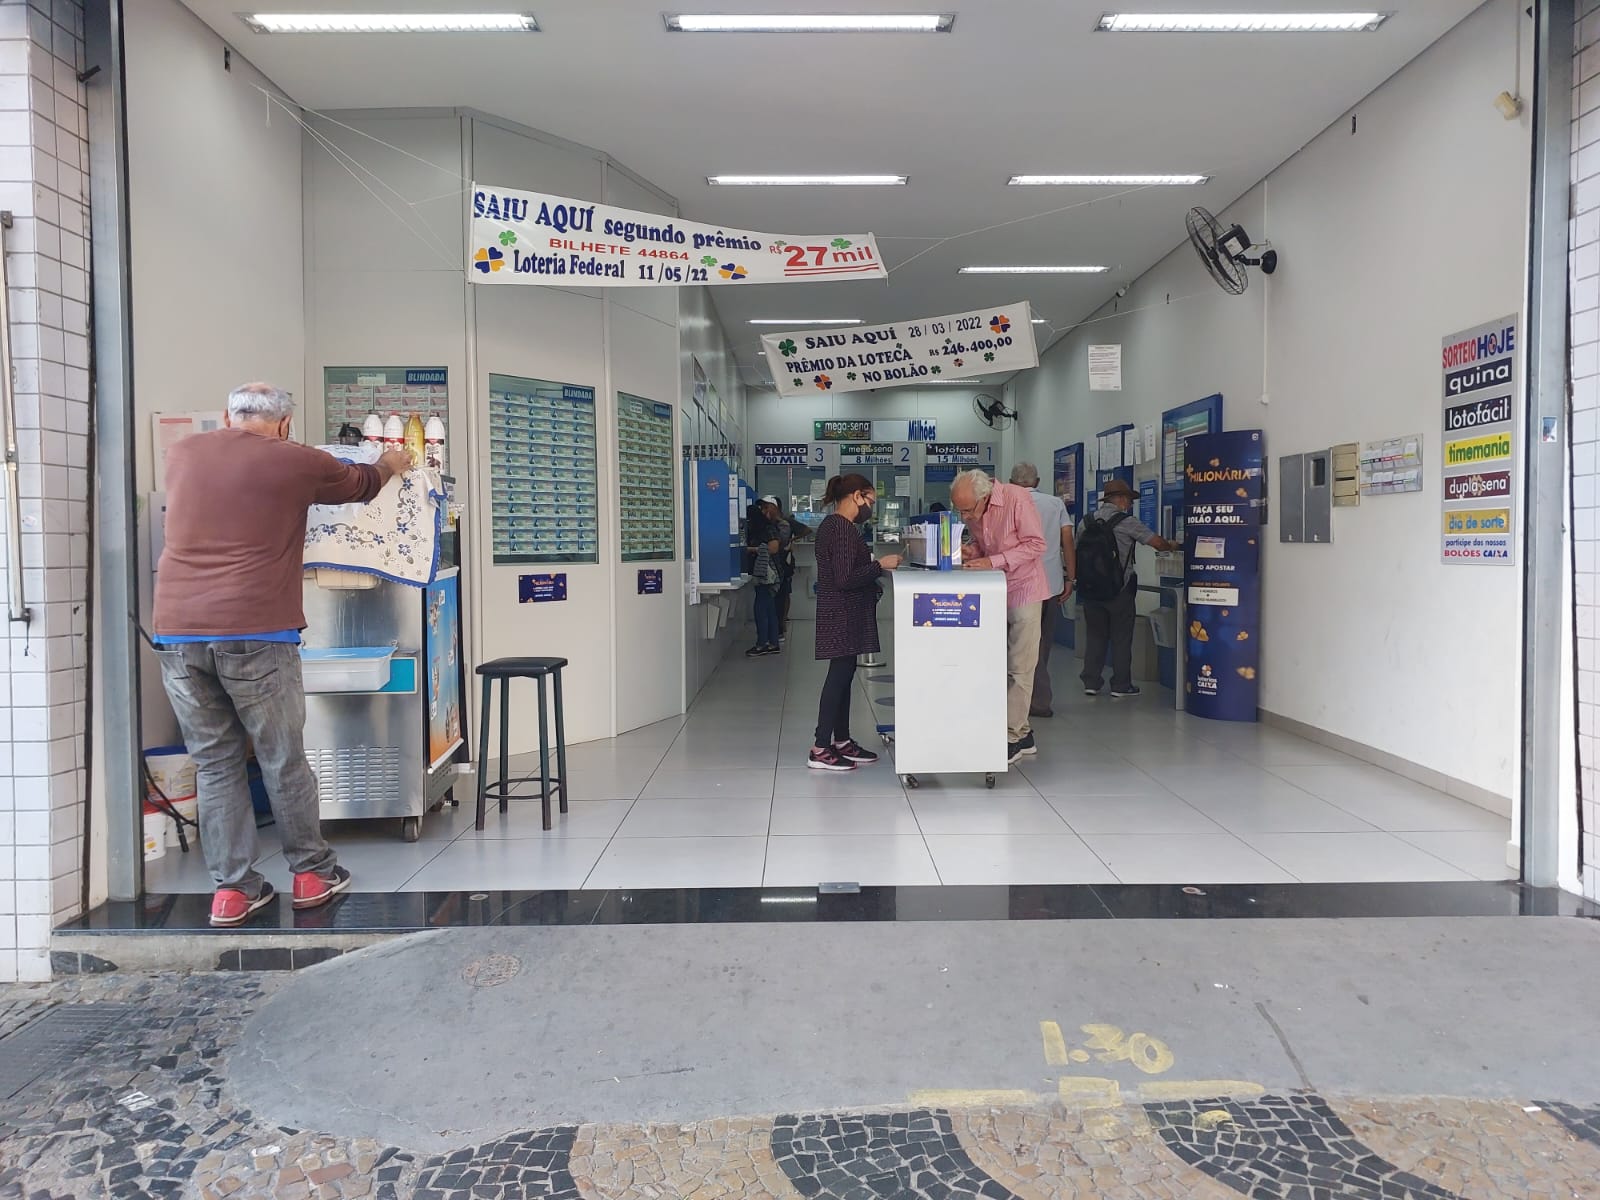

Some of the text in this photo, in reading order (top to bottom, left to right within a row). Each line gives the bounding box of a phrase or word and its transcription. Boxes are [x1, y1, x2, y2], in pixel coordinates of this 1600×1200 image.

[474, 191, 762, 251] SAIU AQUÍ segundo prêmio
[550, 238, 689, 260] BILHETE 44864
[784, 245, 828, 267] 27
[832, 246, 873, 263] mil
[513, 249, 566, 275] Loteria
[570, 254, 625, 278] Federal
[805, 334, 847, 350] SAIU
[852, 326, 897, 345] AQUÍ
[785, 357, 835, 374] PRÊMIO
[836, 355, 857, 369] DA
[858, 348, 913, 366] LOTECA
[941, 336, 1013, 356] 246.400,00
[862, 362, 928, 383] NO BOLÃO
[1449, 365, 1509, 393] quina
[825, 421, 869, 434] mega-sena
[764, 445, 807, 455] quina
[815, 447, 824, 462] 3
[900, 447, 910, 462] 2
[986, 446, 992, 462] 1
[1448, 435, 1510, 463] timemania
[761, 456, 807, 464] 700 MIL
[856, 456, 862, 464] 8
[1449, 477, 1507, 497] dupla sena
[1214, 515, 1244, 524] AQUI.
[1216, 505, 1234, 514] SEU
[1444, 548, 1508, 558] BOLÕES CAIXA
[1040, 1020, 1175, 1074] 1.30
